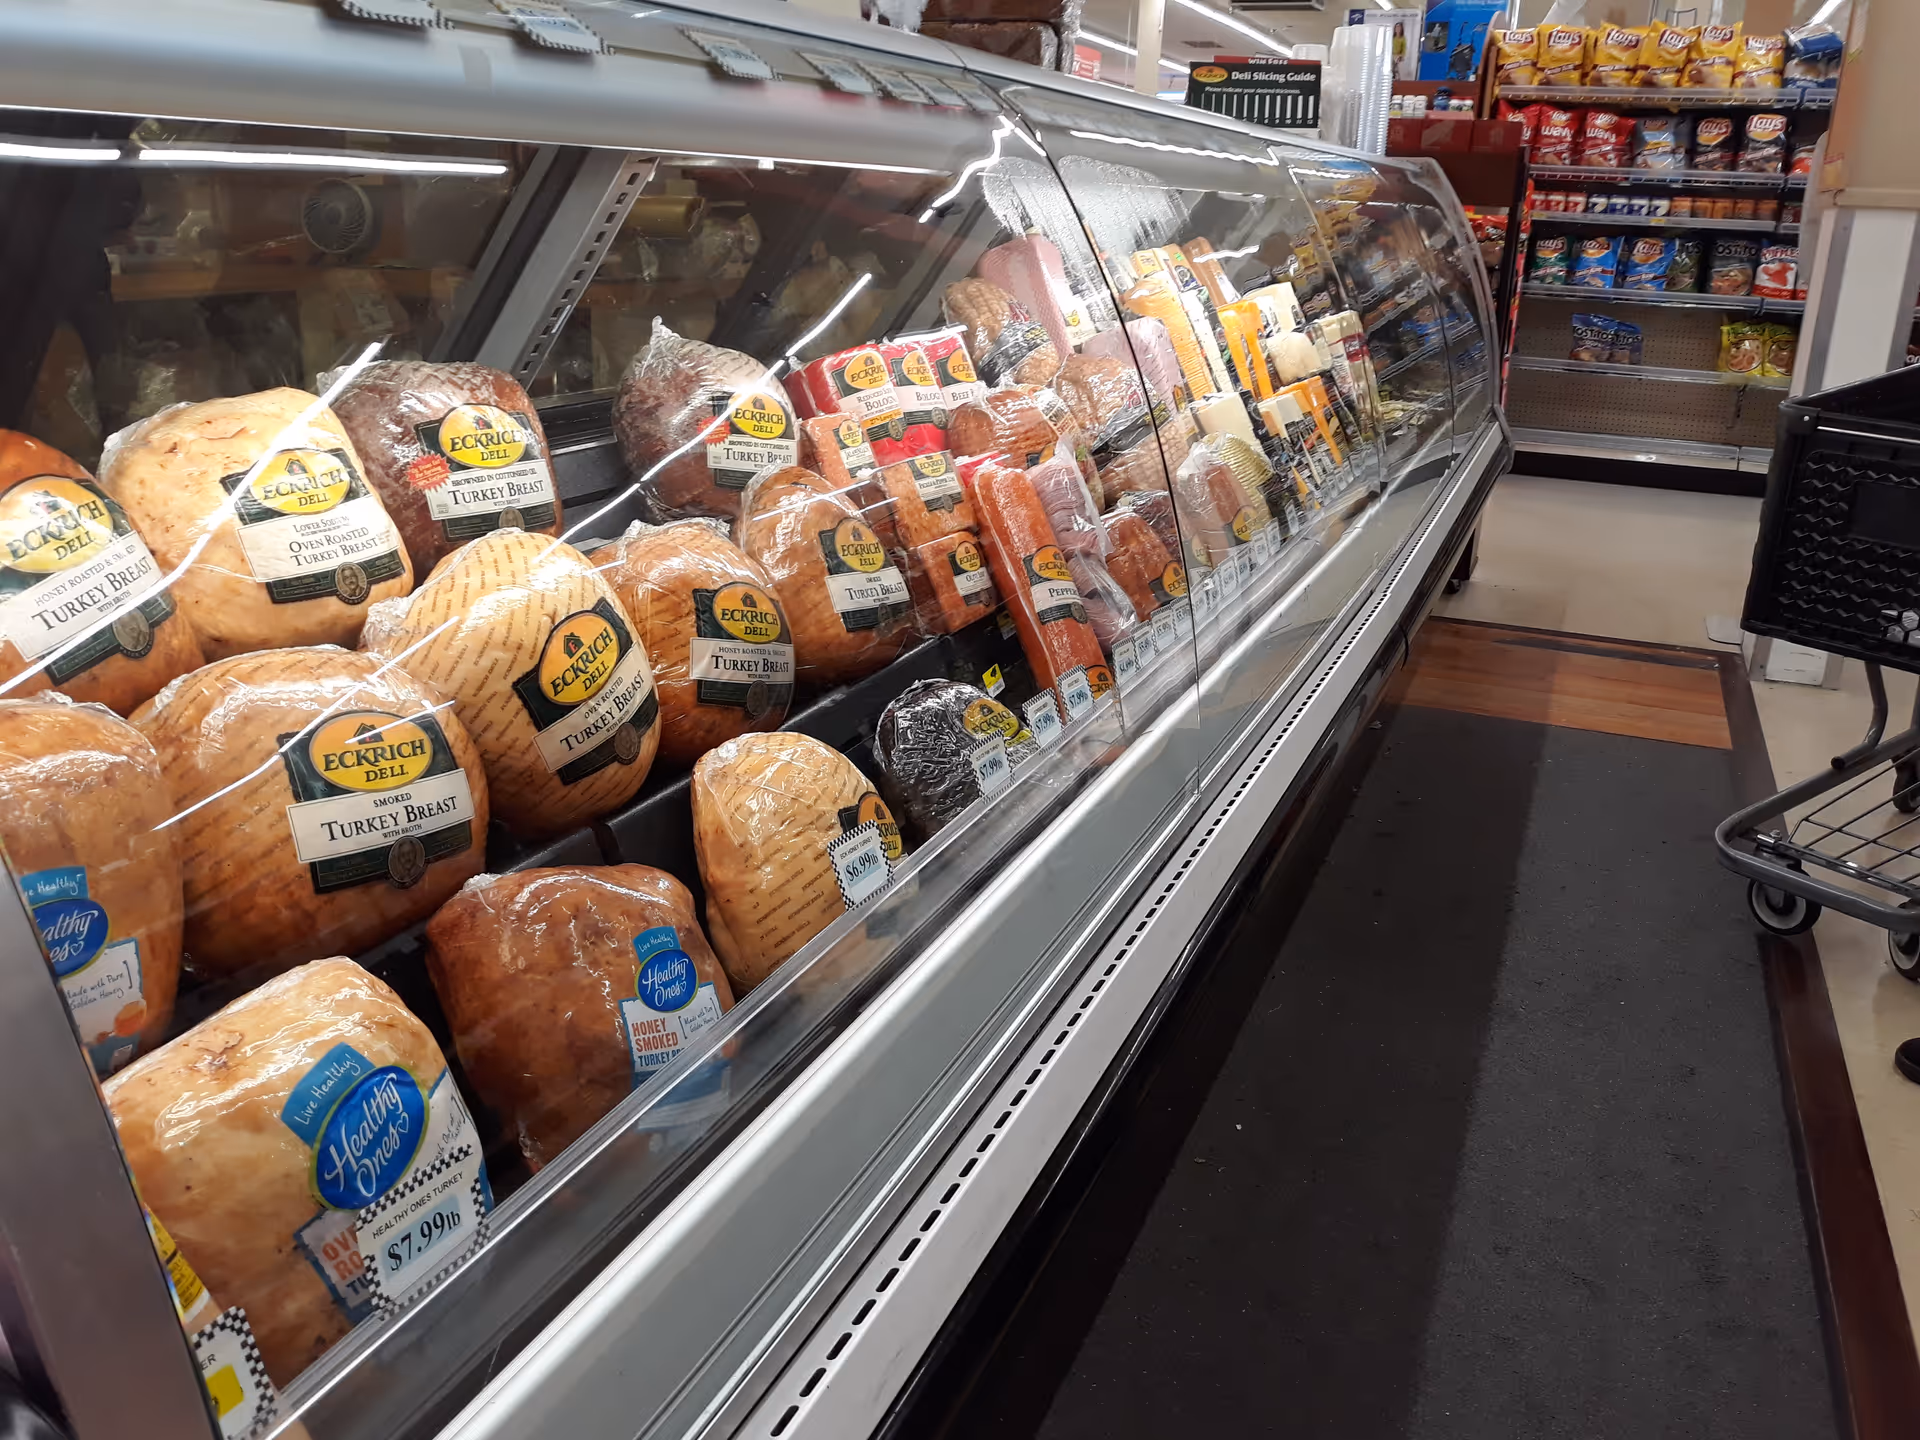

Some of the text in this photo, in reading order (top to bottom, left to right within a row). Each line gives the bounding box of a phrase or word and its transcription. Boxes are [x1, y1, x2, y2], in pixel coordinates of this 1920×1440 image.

[1231, 71, 1316, 83] Deli Slicing Guide
[733, 407, 784, 425] ECKRICH
[752, 424, 775, 434] DELI
[480, 449, 510, 461] DELI
[723, 447, 765, 464] TURKEY
[262, 471, 344, 500] ECKRICH
[447, 479, 545, 506] TURKEY BREAST
[298, 492, 330, 507] DELI
[5, 499, 105, 563] ECKRICH
[288, 526, 370, 555] OVEN ROASTED
[54, 531, 97, 561] DELI
[289, 537, 379, 568] TURKEY BREAST
[840, 542, 881, 558] ECKRICH
[31, 556, 152, 633] TURKEY BREAST
[35, 580, 69, 608] HONEY
[69, 562, 105, 589] ROASTED
[844, 581, 905, 601] TURKEY BREAST
[1048, 583, 1079, 597] PEPPER
[720, 608, 779, 627] ECKRICH
[743, 625, 771, 637] DELI
[550, 626, 615, 698] ECKRICH
[711, 654, 790, 673] TURKEY BREAST
[718, 646, 741, 655] HONEY
[741, 647, 767, 656] ROASTED
[581, 660, 610, 693] DELI
[559, 669, 646, 753] TURKEY BREAST
[584, 676, 625, 720] OVEN ROASTED
[323, 738, 428, 772] ECKRICH
[364, 764, 407, 783] DELI
[373, 792, 413, 808] SMOKED
[321, 796, 458, 842] TURKEY BREAST
[382, 823, 423, 839] WITH BROTH
[847, 844, 860, 857] HONEY
[859, 835, 874, 848] TURKEY
[845, 851, 879, 883] $6.99lb
[641, 957, 689, 995] Healthy
[654, 982, 681, 1008] Ones
[631, 1017, 667, 1038] HONEY
[634, 1031, 679, 1053] SMOKED
[637, 1050, 671, 1068] TURKEY
[294, 1053, 362, 1126] Live Healthy!
[324, 1072, 404, 1193] Healthy
[356, 1125, 401, 1198] Ones
[372, 1170, 464, 1240] HEALTHY ONES TURKEY
[387, 1209, 461, 1272] $7.99lb
